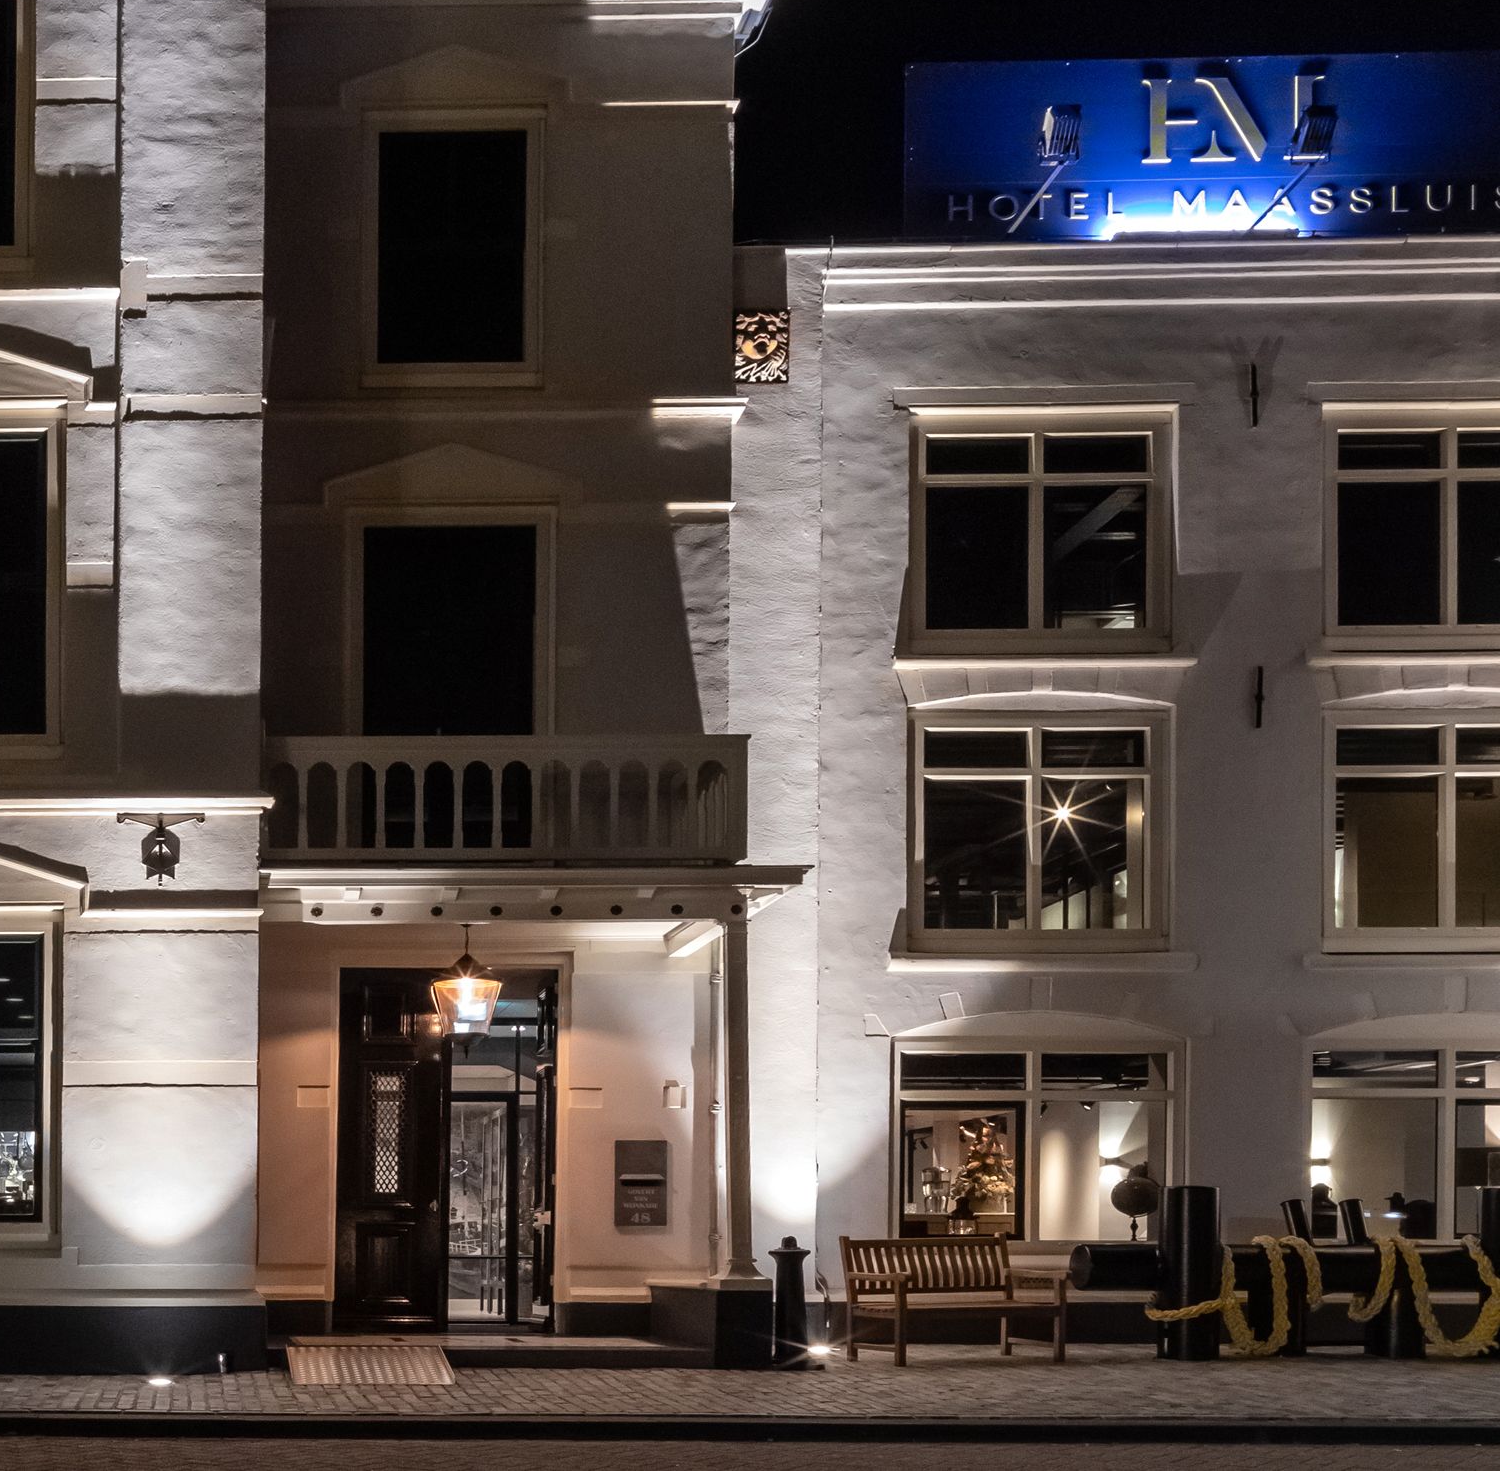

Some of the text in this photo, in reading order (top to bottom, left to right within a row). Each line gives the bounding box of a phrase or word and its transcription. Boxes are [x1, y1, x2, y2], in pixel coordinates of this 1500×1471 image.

[947, 184, 1500, 222] HOTEL MAASSLUI
[630, 1212, 652, 1224] 48
